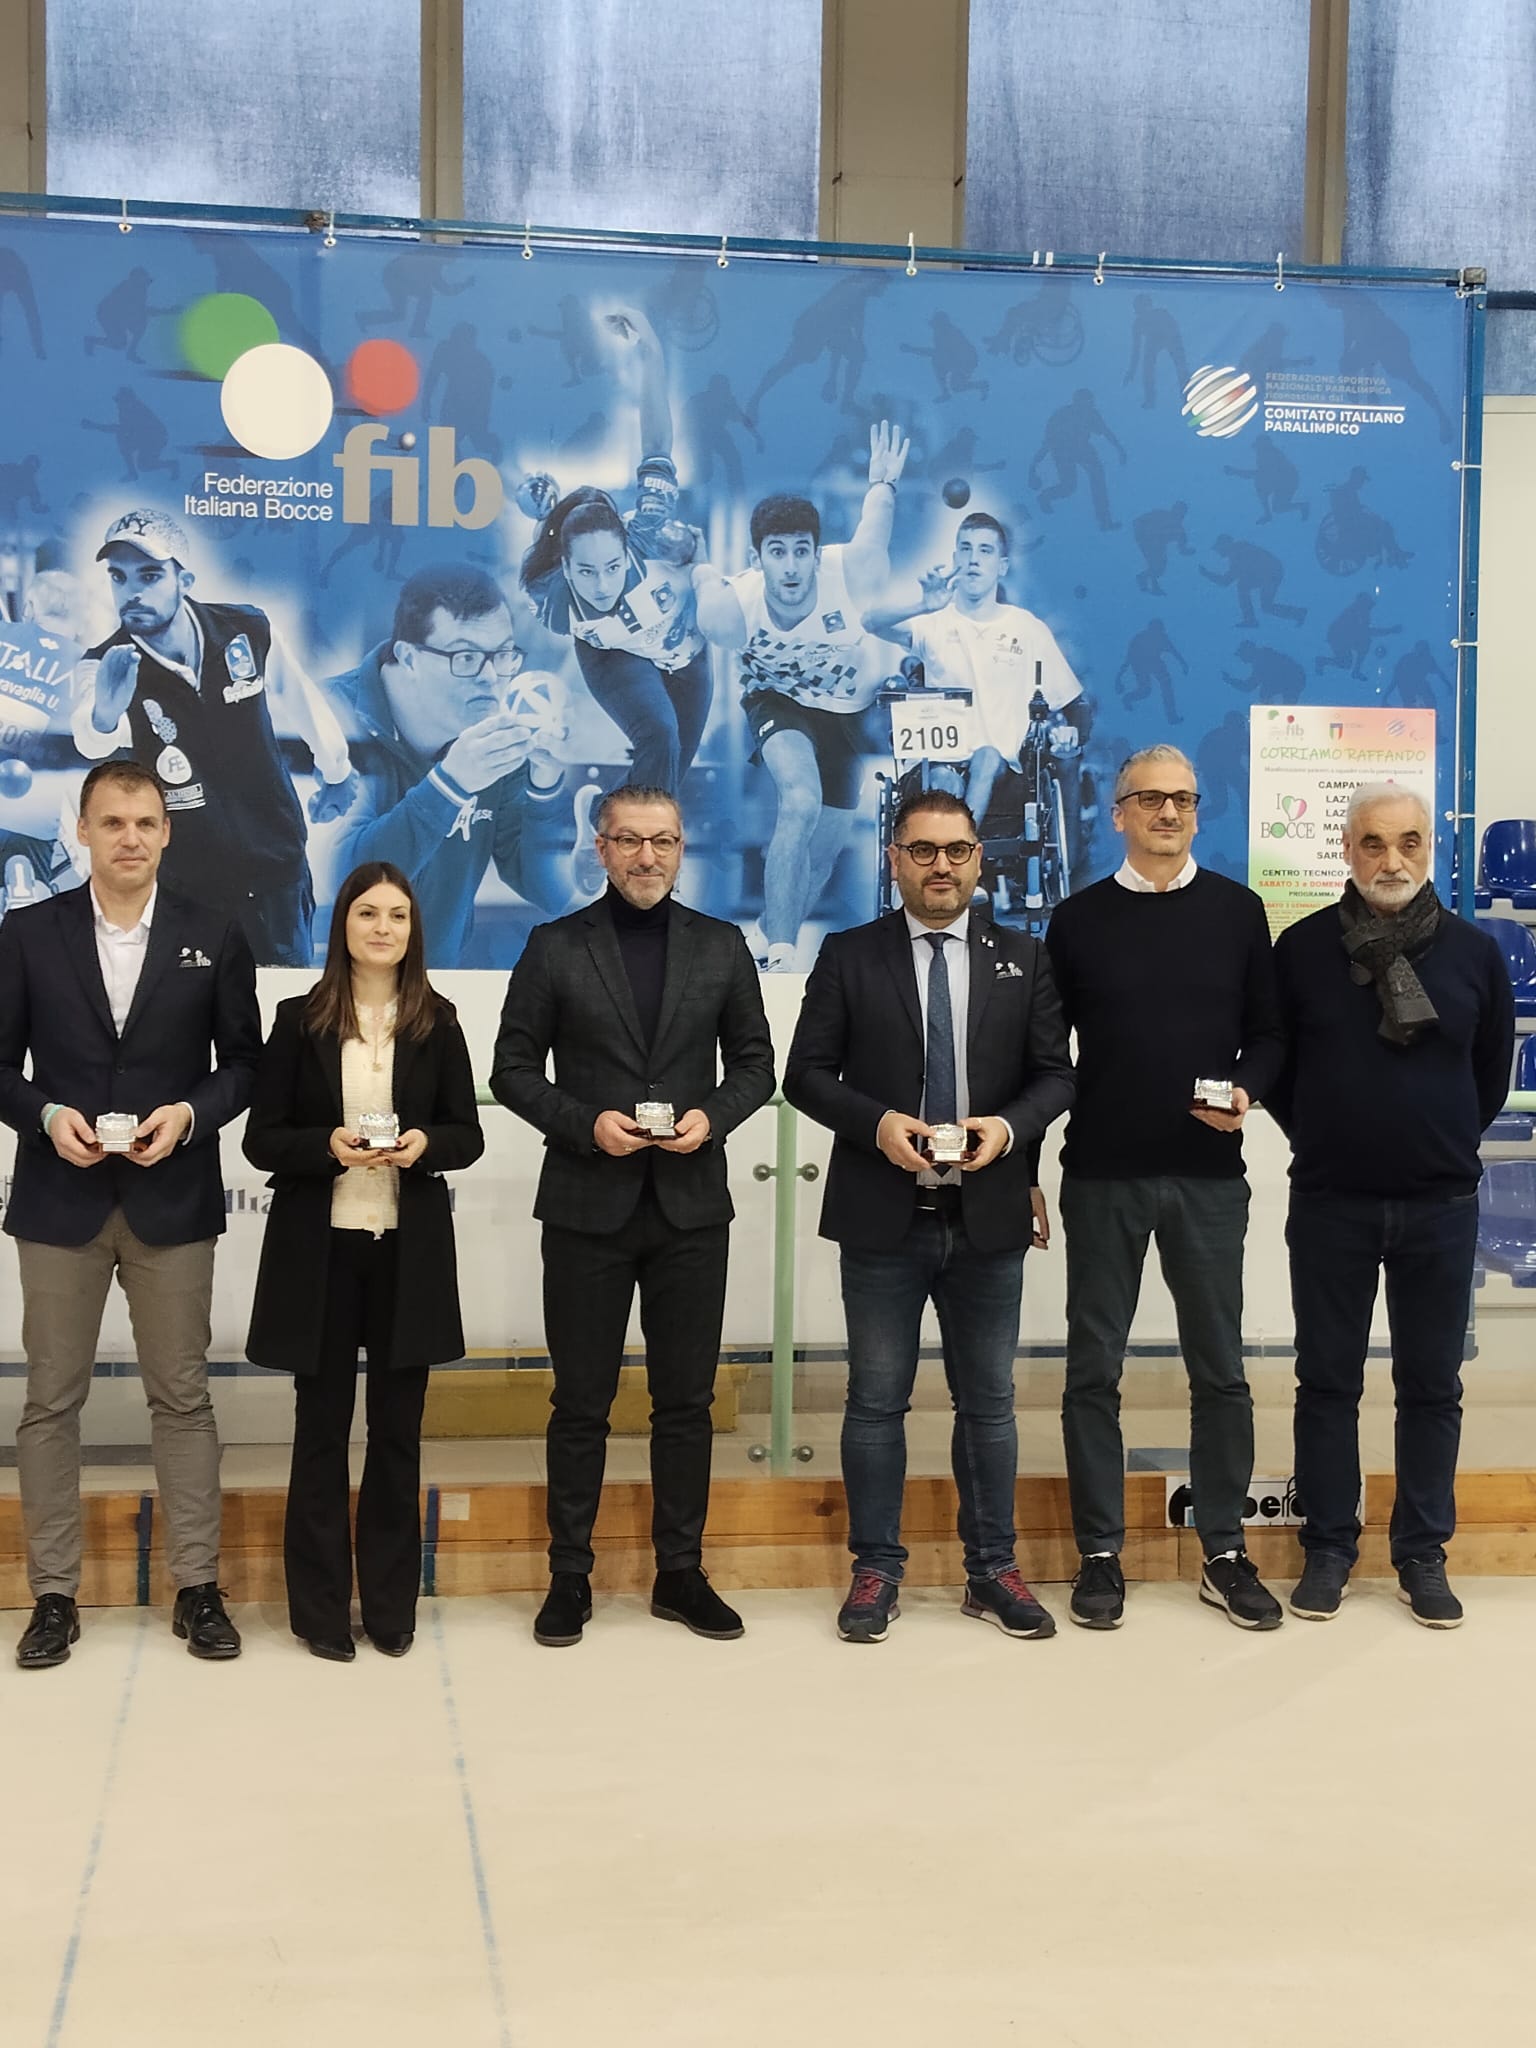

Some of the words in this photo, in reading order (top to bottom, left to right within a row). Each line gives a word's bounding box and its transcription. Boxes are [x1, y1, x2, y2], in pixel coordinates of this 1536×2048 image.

[1265, 372, 1334, 385] FEDERAZIONE
[1337, 375, 1387, 387] SPORTIVA
[1265, 382, 1322, 393] NAZIONALE
[1264, 407, 1336, 421] COMITATO
[1340, 411, 1404, 424] ITALIANO
[1264, 420, 1360, 435] PARALIMPICO
[333, 423, 503, 530] fib
[204, 472, 334, 499] Federazione
[184, 494, 259, 518] Italiana
[264, 498, 334, 521] Bocce
[900, 725, 959, 751] 2109
[1260, 747, 1342, 761] CORRIAMO
[1346, 748, 1426, 762] RAFFANDO
[1260, 821, 1316, 839] BOCCE
[1262, 869, 1300, 877] CENTRO
[1258, 880, 1292, 888] SABATO
